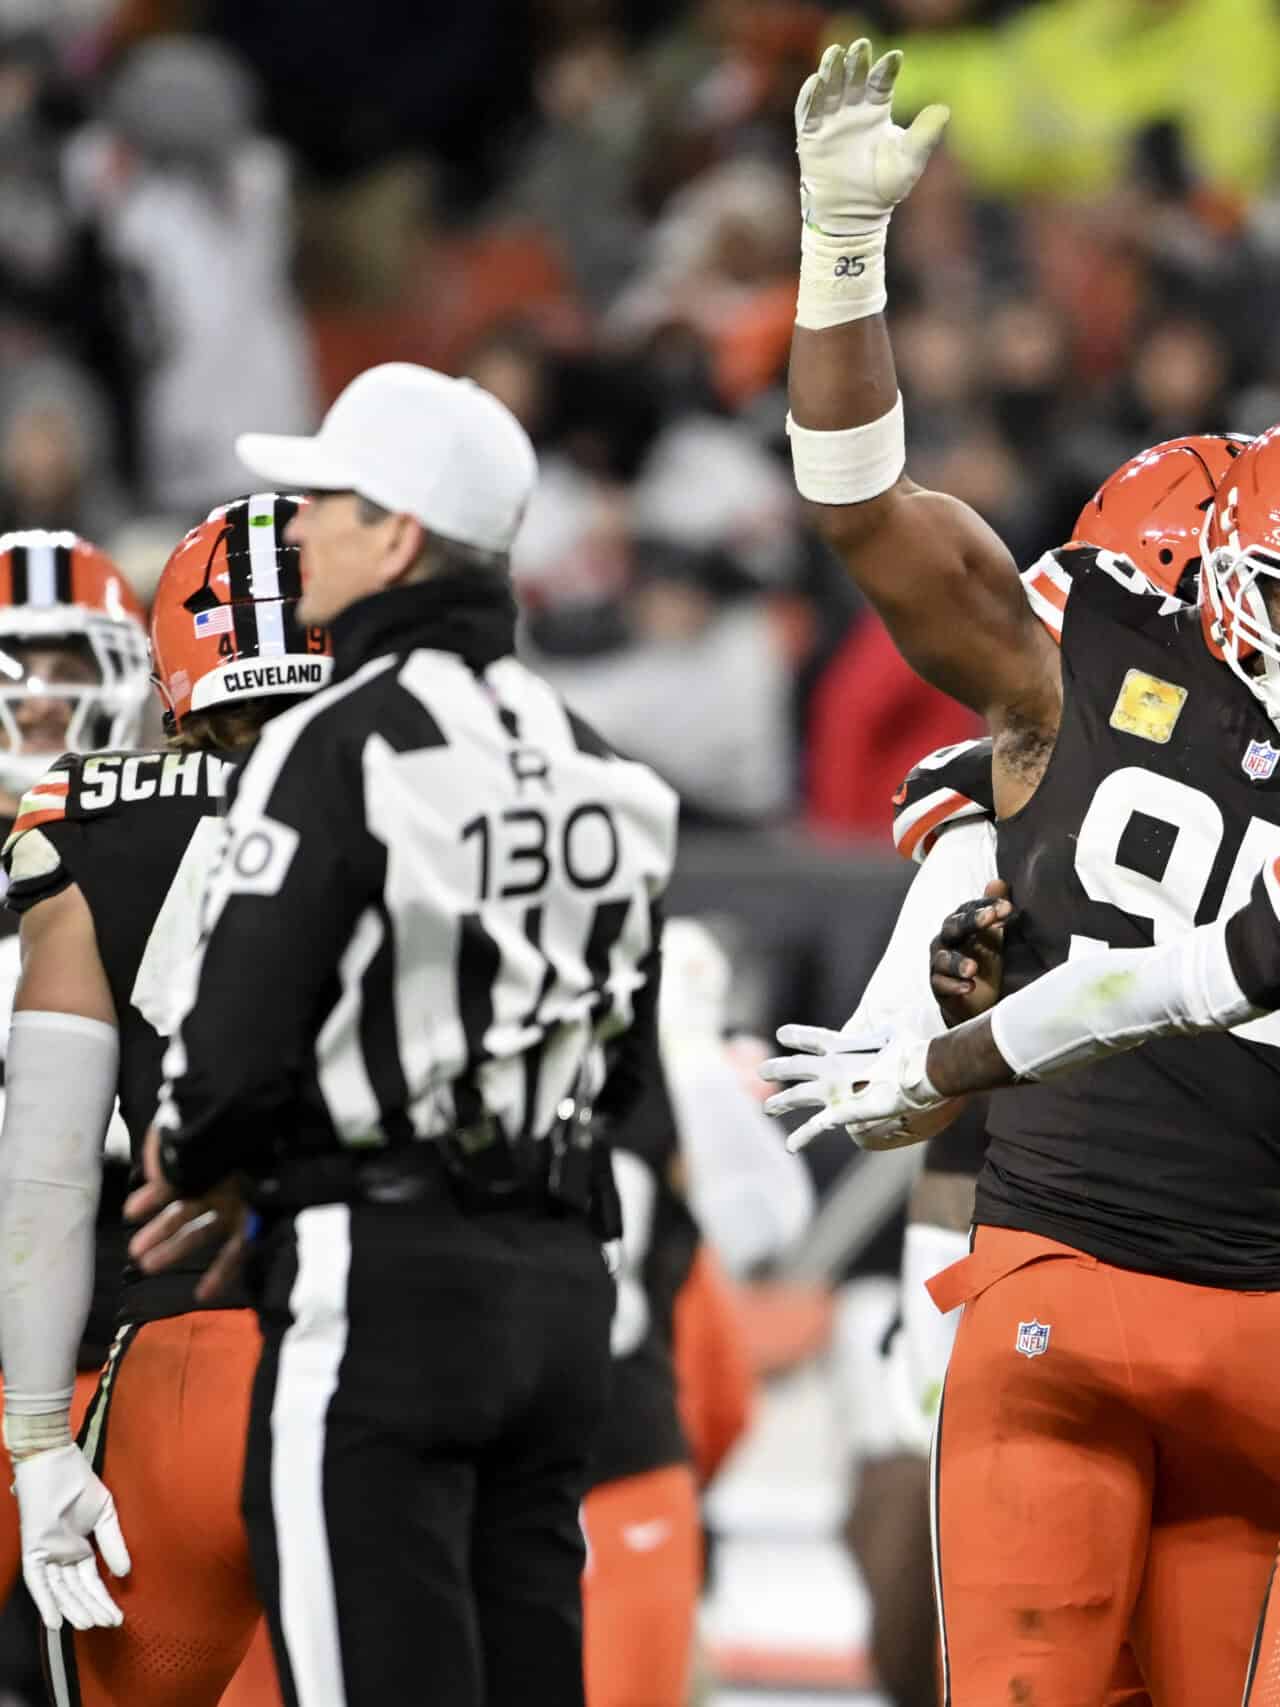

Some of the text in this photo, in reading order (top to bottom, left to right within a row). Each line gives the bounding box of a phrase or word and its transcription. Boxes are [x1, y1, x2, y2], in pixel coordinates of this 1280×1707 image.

[834, 255, 865, 277] 25
[218, 628, 326, 657] 4 9
[223, 664, 322, 693] CLEVELAND
[459, 802, 619, 901] 130
